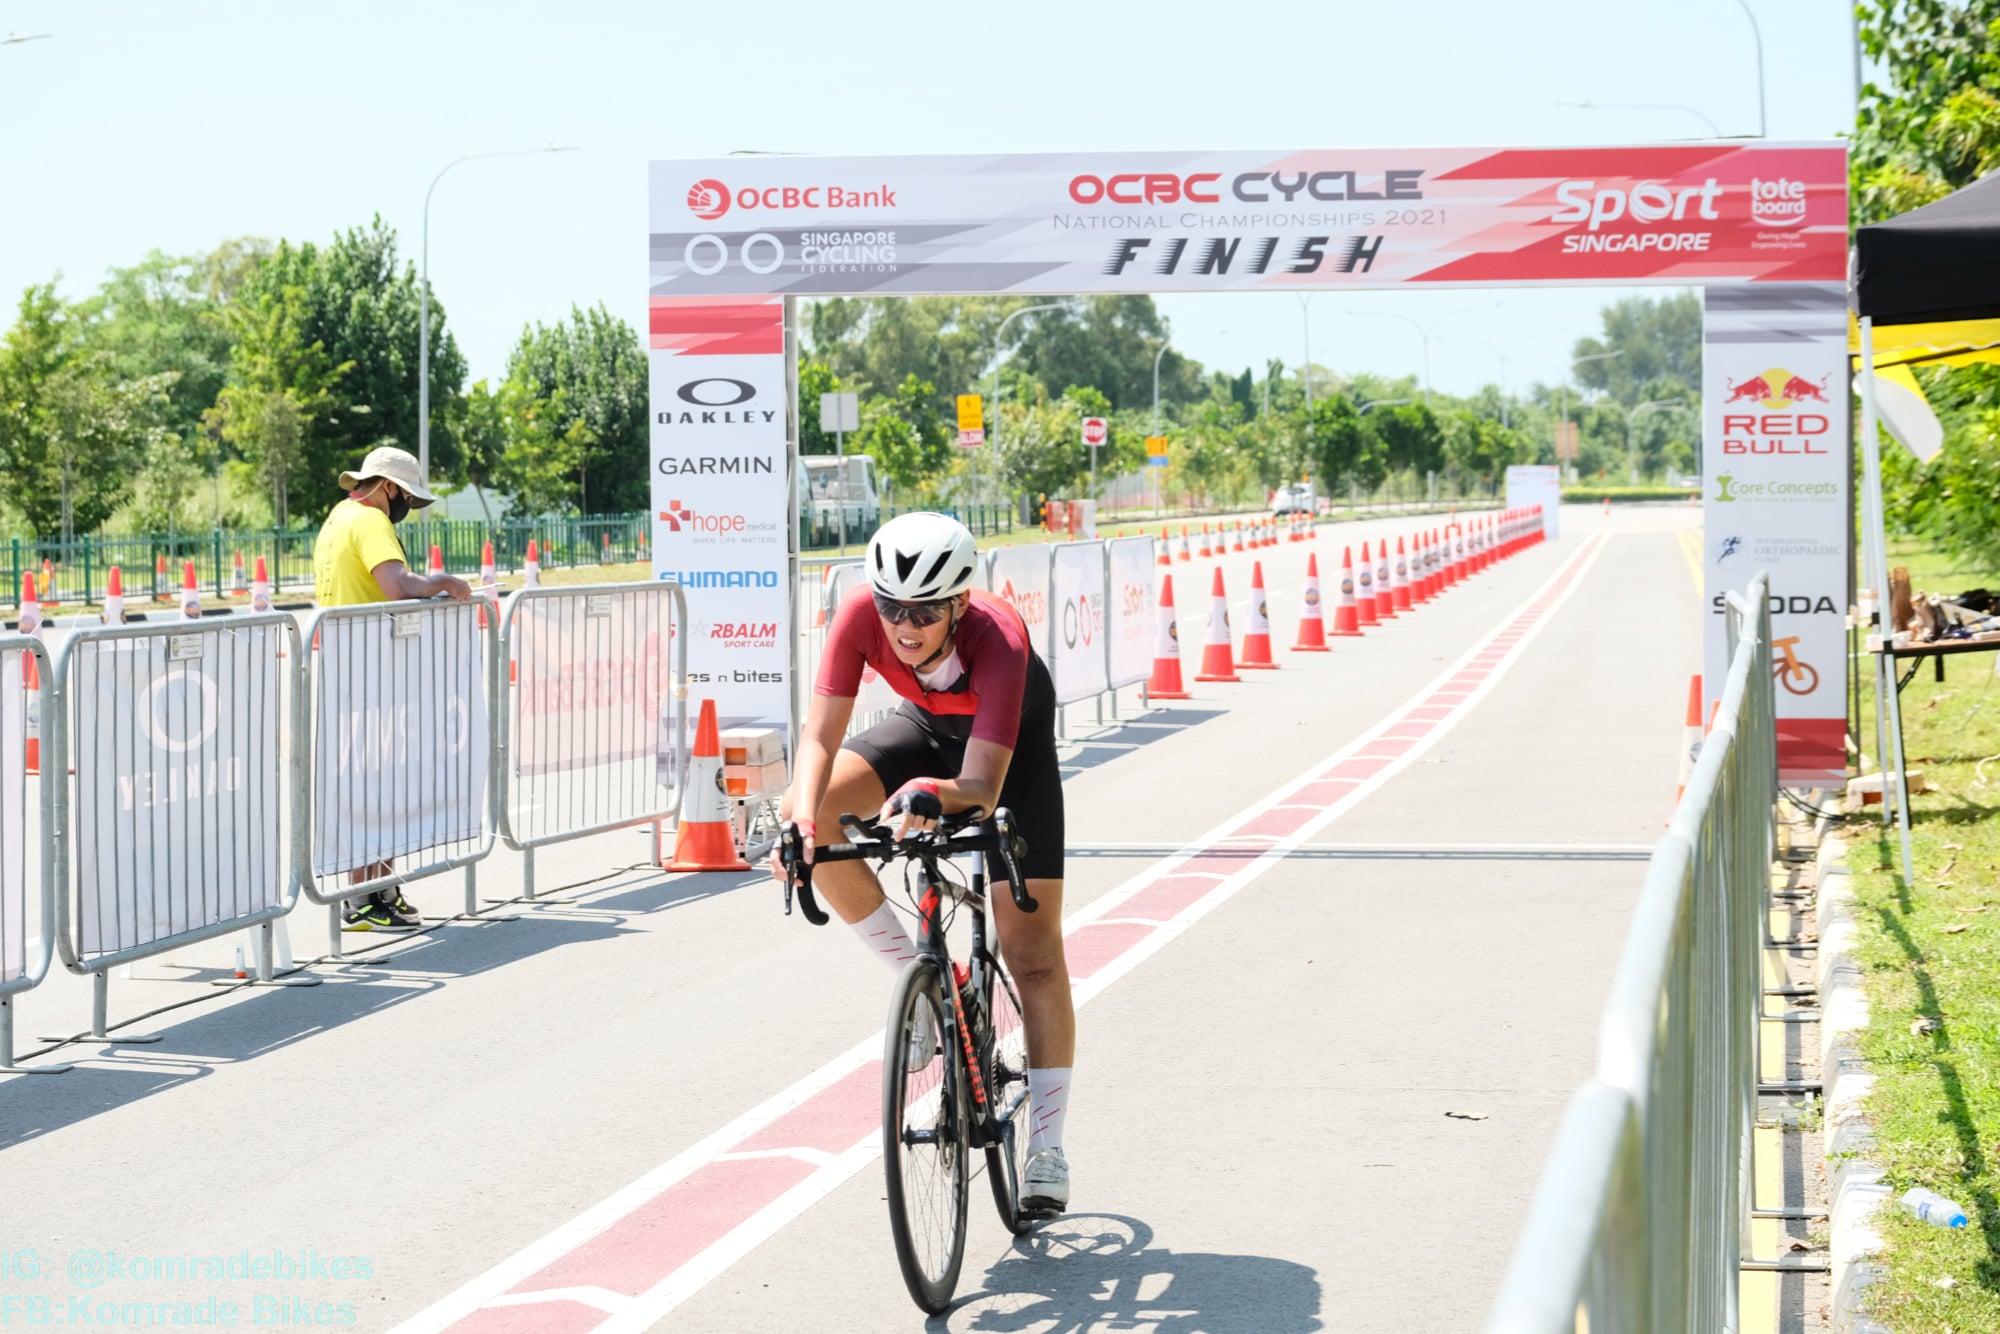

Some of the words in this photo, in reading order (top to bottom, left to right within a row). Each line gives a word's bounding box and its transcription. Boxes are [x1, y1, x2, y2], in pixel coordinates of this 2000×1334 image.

[737, 186, 820, 210] OCBC
[827, 184, 897, 208] Bank
[1068, 172, 1223, 206] OCBC
[1232, 169, 1426, 203] CYCLE
[1751, 177, 1806, 199] tote
[1550, 177, 1724, 232] Sport
[1751, 198, 1806, 215] board
[1385, 209, 1447, 225] 2021
[800, 231, 897, 246] SINGAPORE
[1561, 232, 1712, 254] SINGAPORE
[800, 245, 897, 264] CYCLING
[1100, 235, 1384, 276] FINISH
[800, 264, 897, 273] FEDERATION
[657, 410, 776, 425] OAKLEY
[1723, 414, 1829, 436] RED
[1723, 439, 1829, 455] BULL
[658, 456, 773, 475] GARMIN
[1729, 481, 1765, 495] Core
[1767, 481, 1838, 496] Concepts
[692, 510, 745, 537] hope
[1713, 591, 1837, 615] ŠODA
[723, 640, 752, 649] SPORT
[754, 640, 775, 648] CARE
[733, 669, 783, 683] bites
